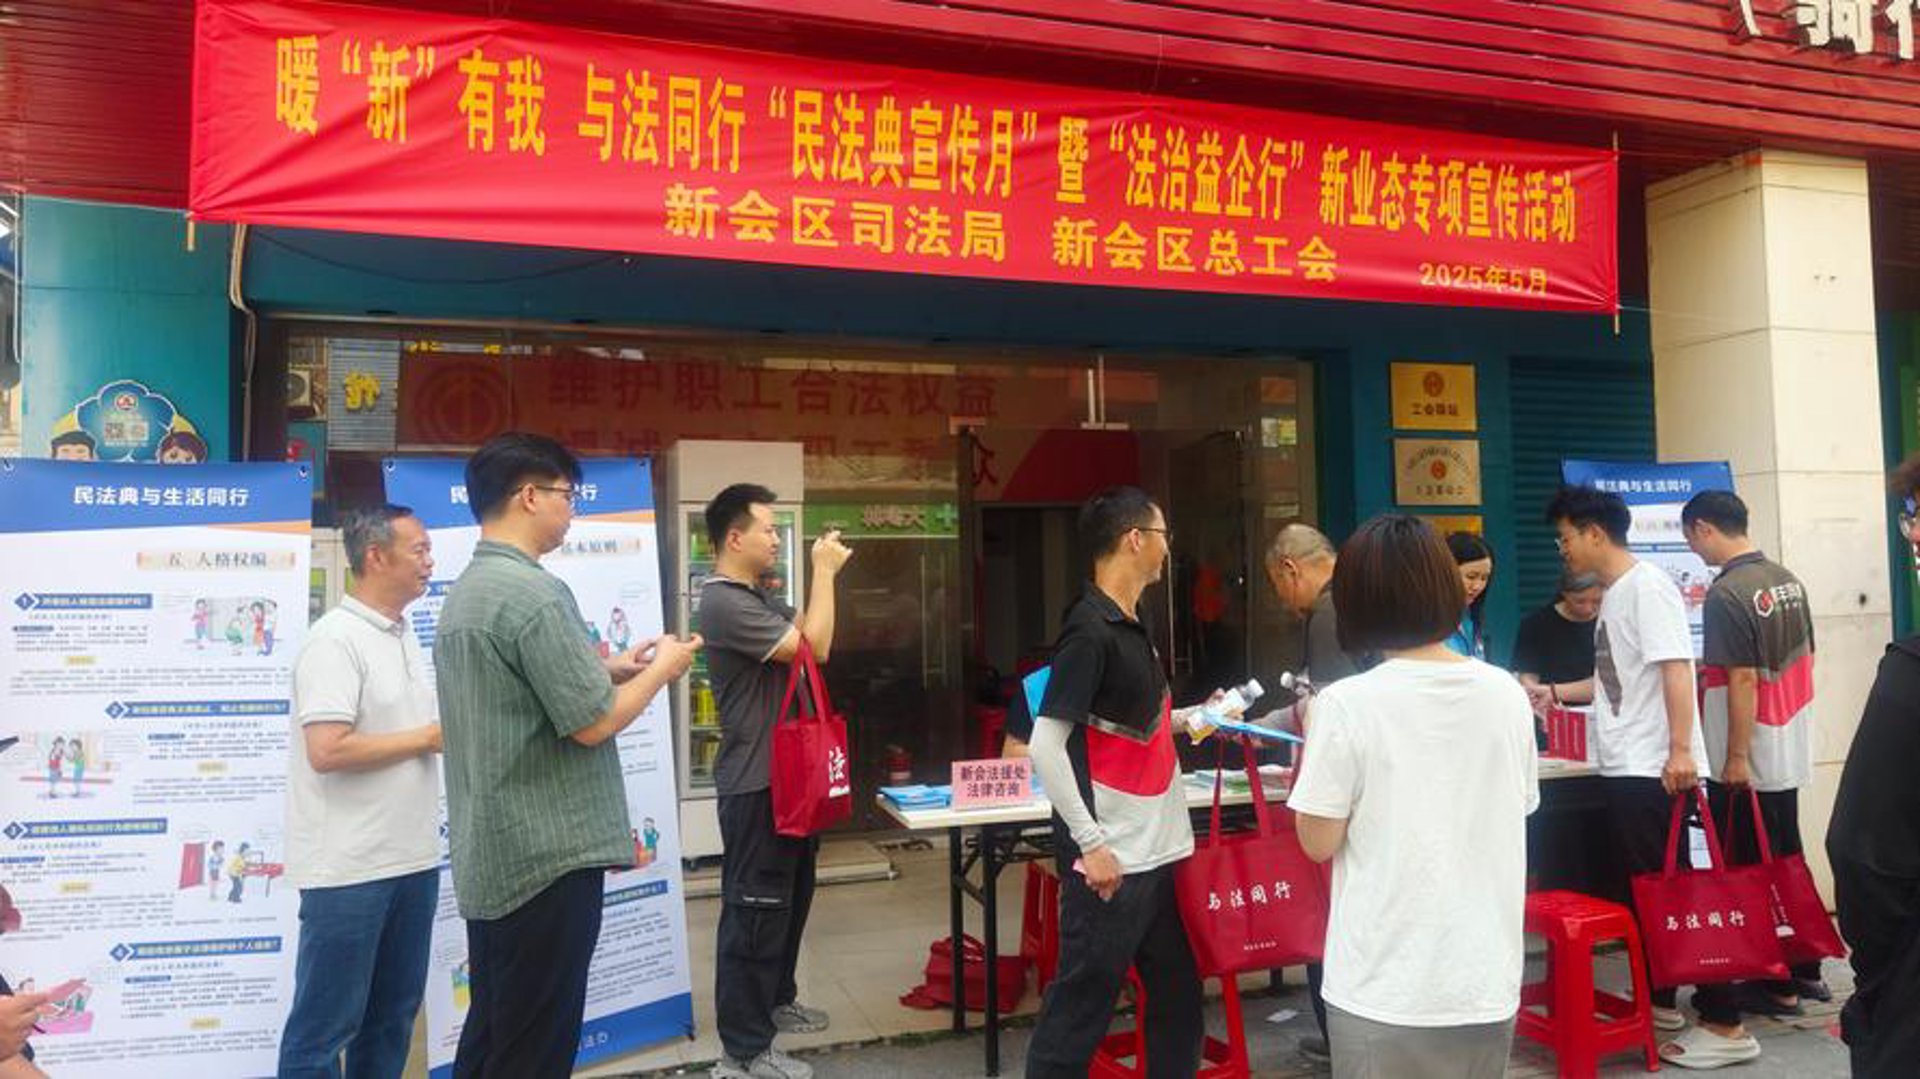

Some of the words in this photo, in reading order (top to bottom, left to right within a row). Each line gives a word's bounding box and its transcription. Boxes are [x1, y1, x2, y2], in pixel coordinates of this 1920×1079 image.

[666, 185, 1005, 262] 新会区司法局
[1052, 216, 1337, 283] 新会区总工会
[1419, 262, 1549, 297] 2025年5月
[73, 484, 250, 507] 民法典与生活同行
